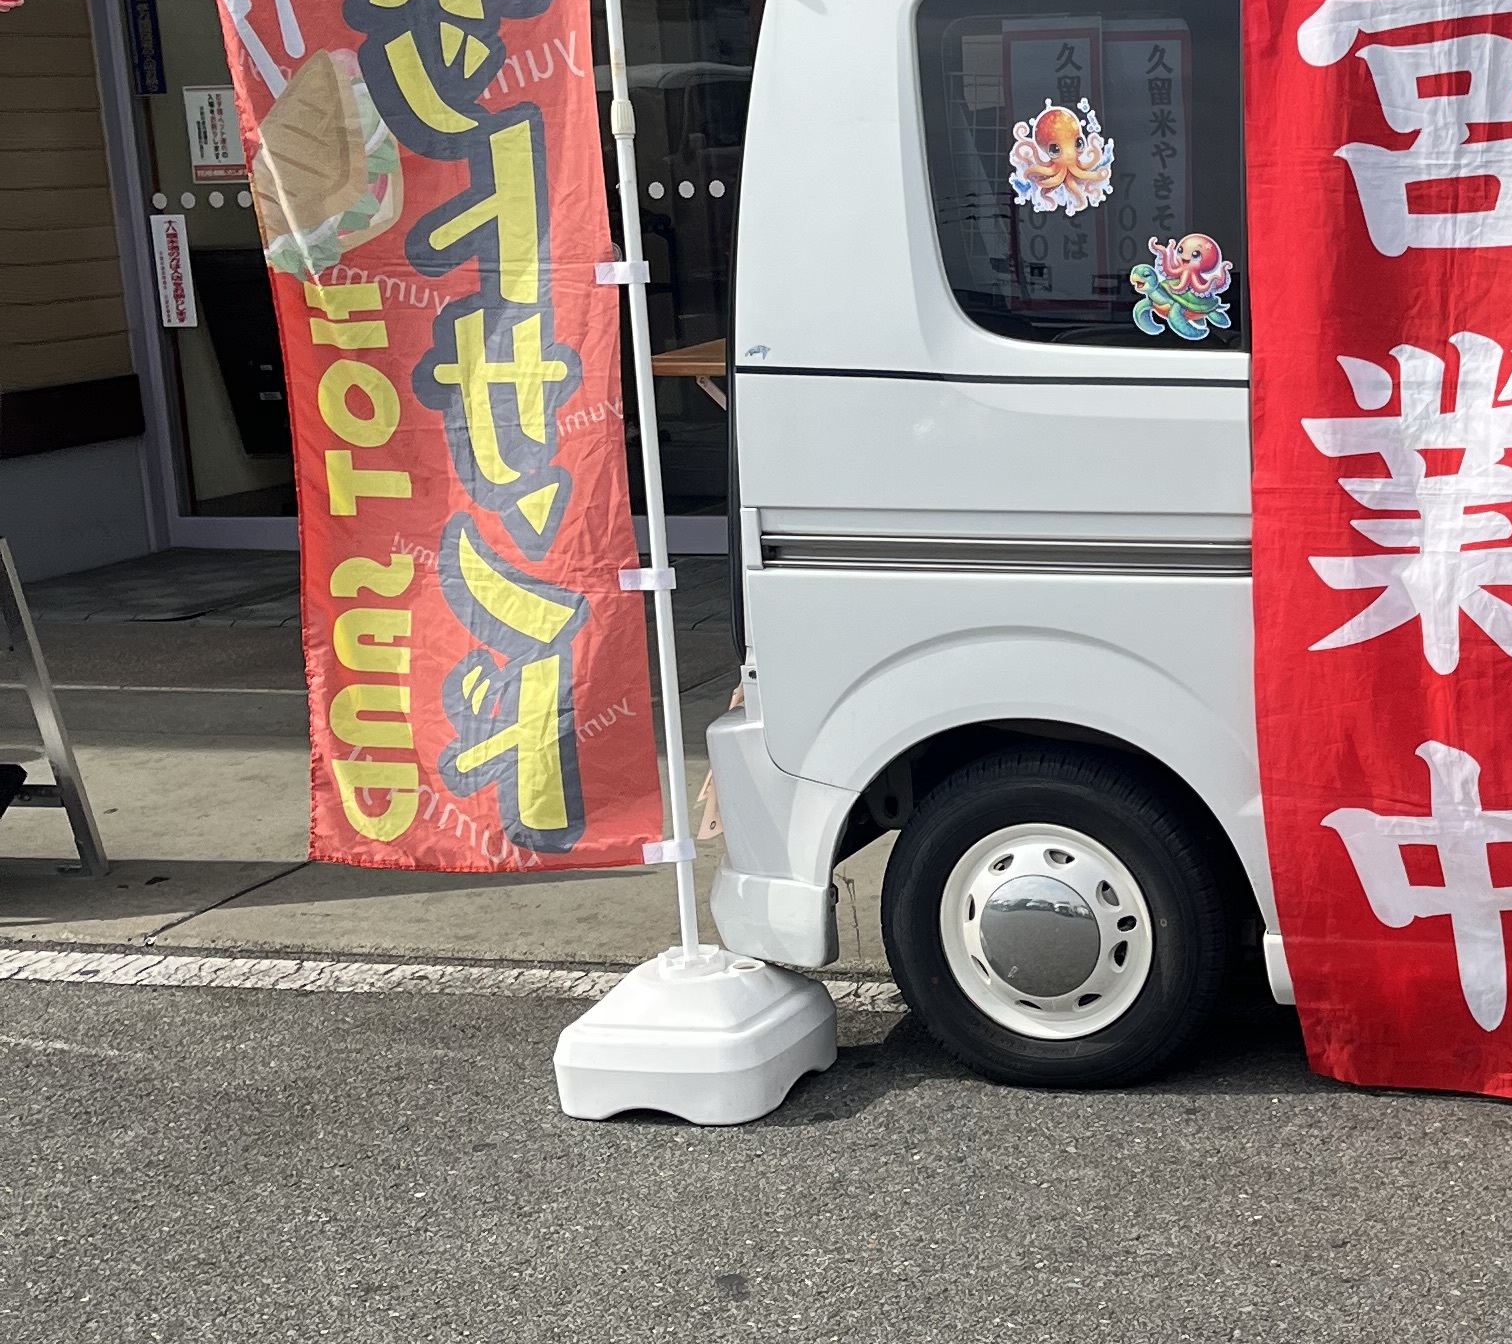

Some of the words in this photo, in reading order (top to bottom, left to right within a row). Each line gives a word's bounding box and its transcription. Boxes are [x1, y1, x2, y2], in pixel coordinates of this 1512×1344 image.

[1145, 44, 1178, 232] 久留米やきそ
